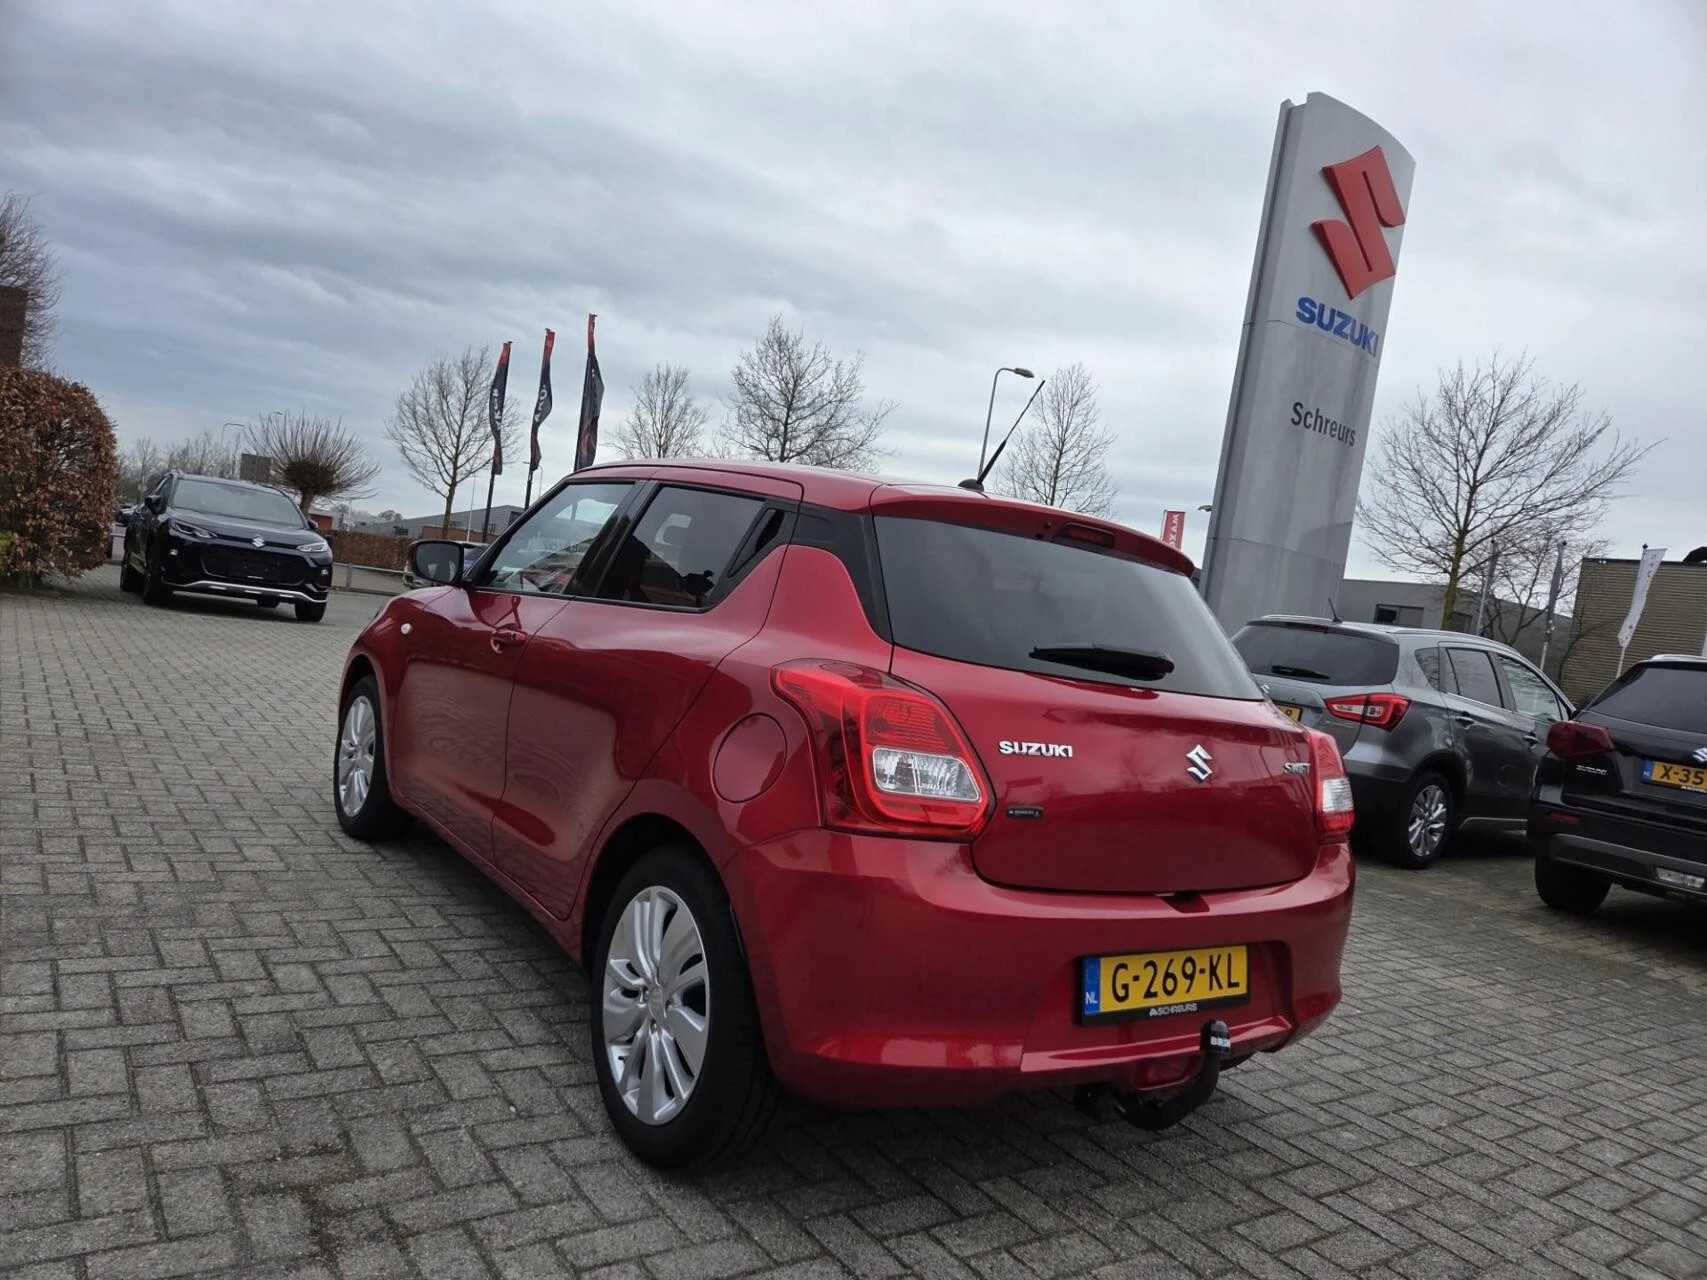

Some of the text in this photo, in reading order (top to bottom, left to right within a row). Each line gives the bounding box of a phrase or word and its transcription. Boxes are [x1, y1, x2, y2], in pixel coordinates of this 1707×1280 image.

[1296, 296, 1379, 358] SUZUKI
[1291, 401, 1356, 448] Schreurs
[999, 740, 1073, 758] SUZUKI
[1085, 991, 1099, 1005] NL
[1111, 953, 1240, 1003] G-269-KL
